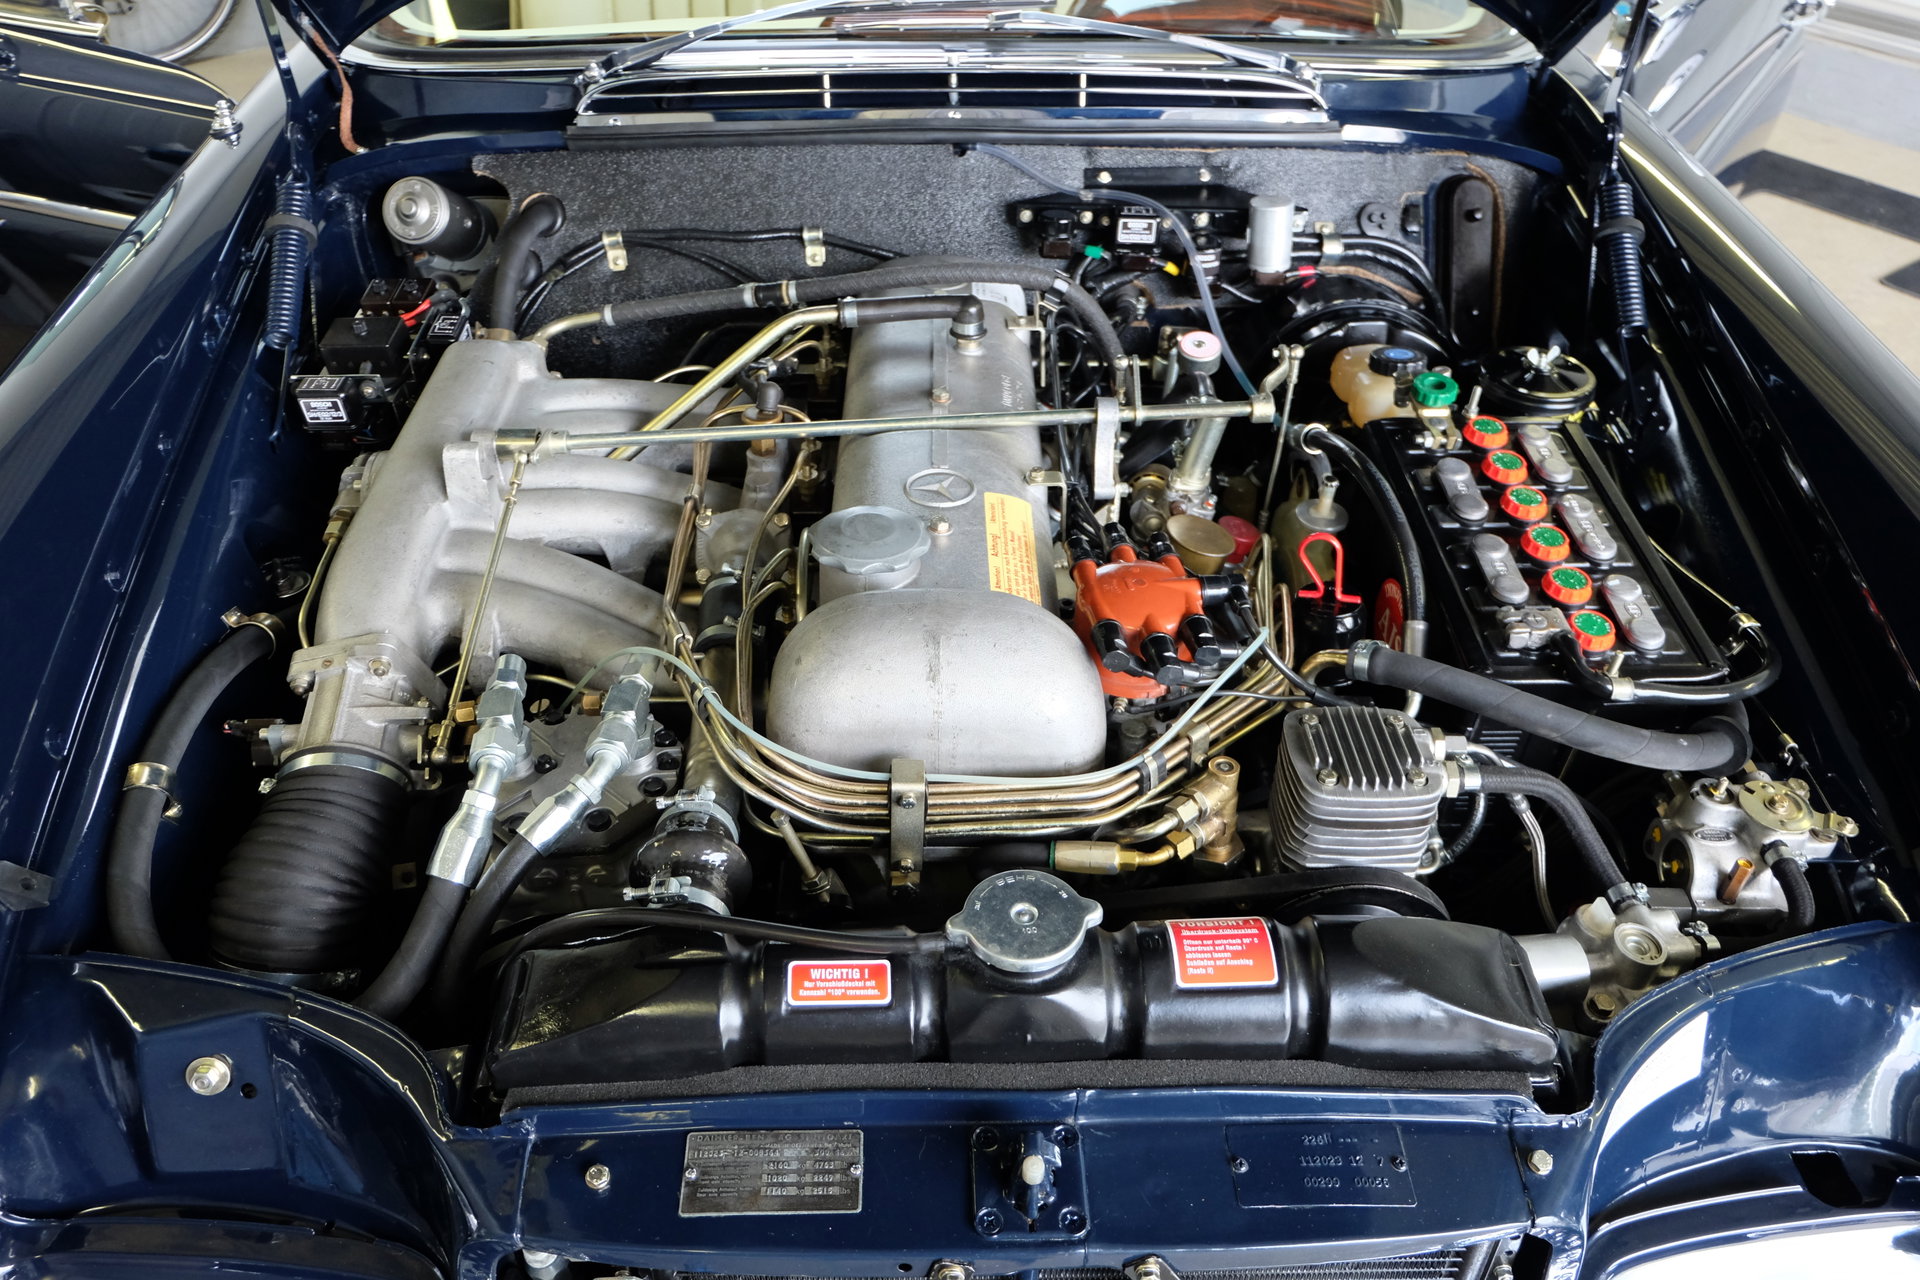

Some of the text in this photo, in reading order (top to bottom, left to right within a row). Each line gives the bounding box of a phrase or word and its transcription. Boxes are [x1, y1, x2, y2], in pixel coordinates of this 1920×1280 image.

[991, 534, 1001, 557] Achtung!
[995, 875, 1036, 886] BEHR
[810, 968, 860, 979] WICHTIG
